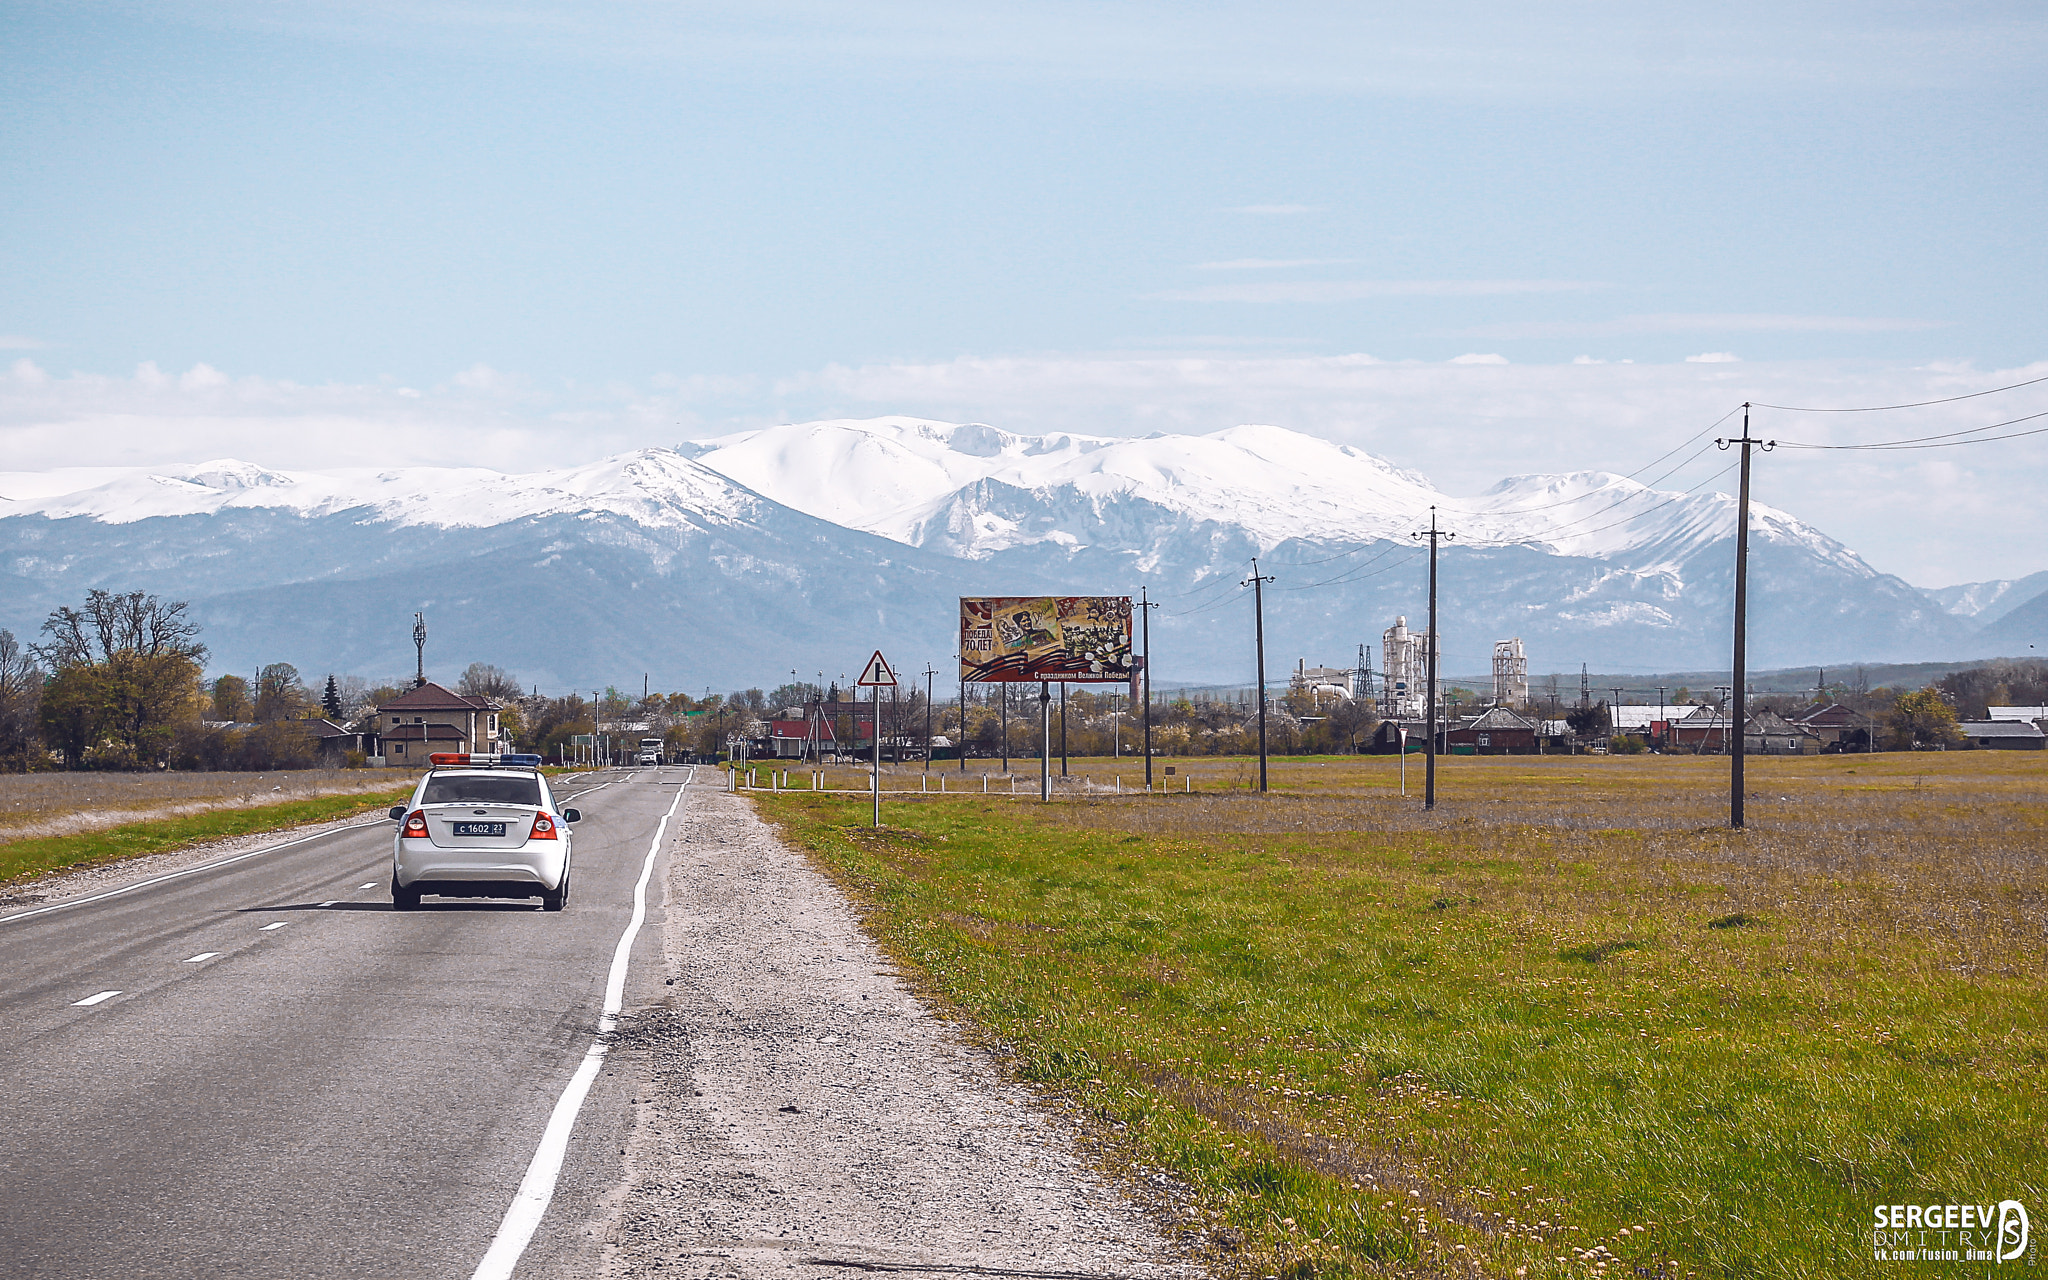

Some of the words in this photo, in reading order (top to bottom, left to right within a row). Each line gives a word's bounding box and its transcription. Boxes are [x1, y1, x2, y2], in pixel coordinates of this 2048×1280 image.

[964, 630, 992, 639] ПОБЕДА!
[965, 639, 976, 651] 70
[977, 639, 992, 651] ЛЕТ
[1034, 671, 1039, 679] С
[468, 824, 489, 833] 1602
[493, 823, 503, 831] 23
